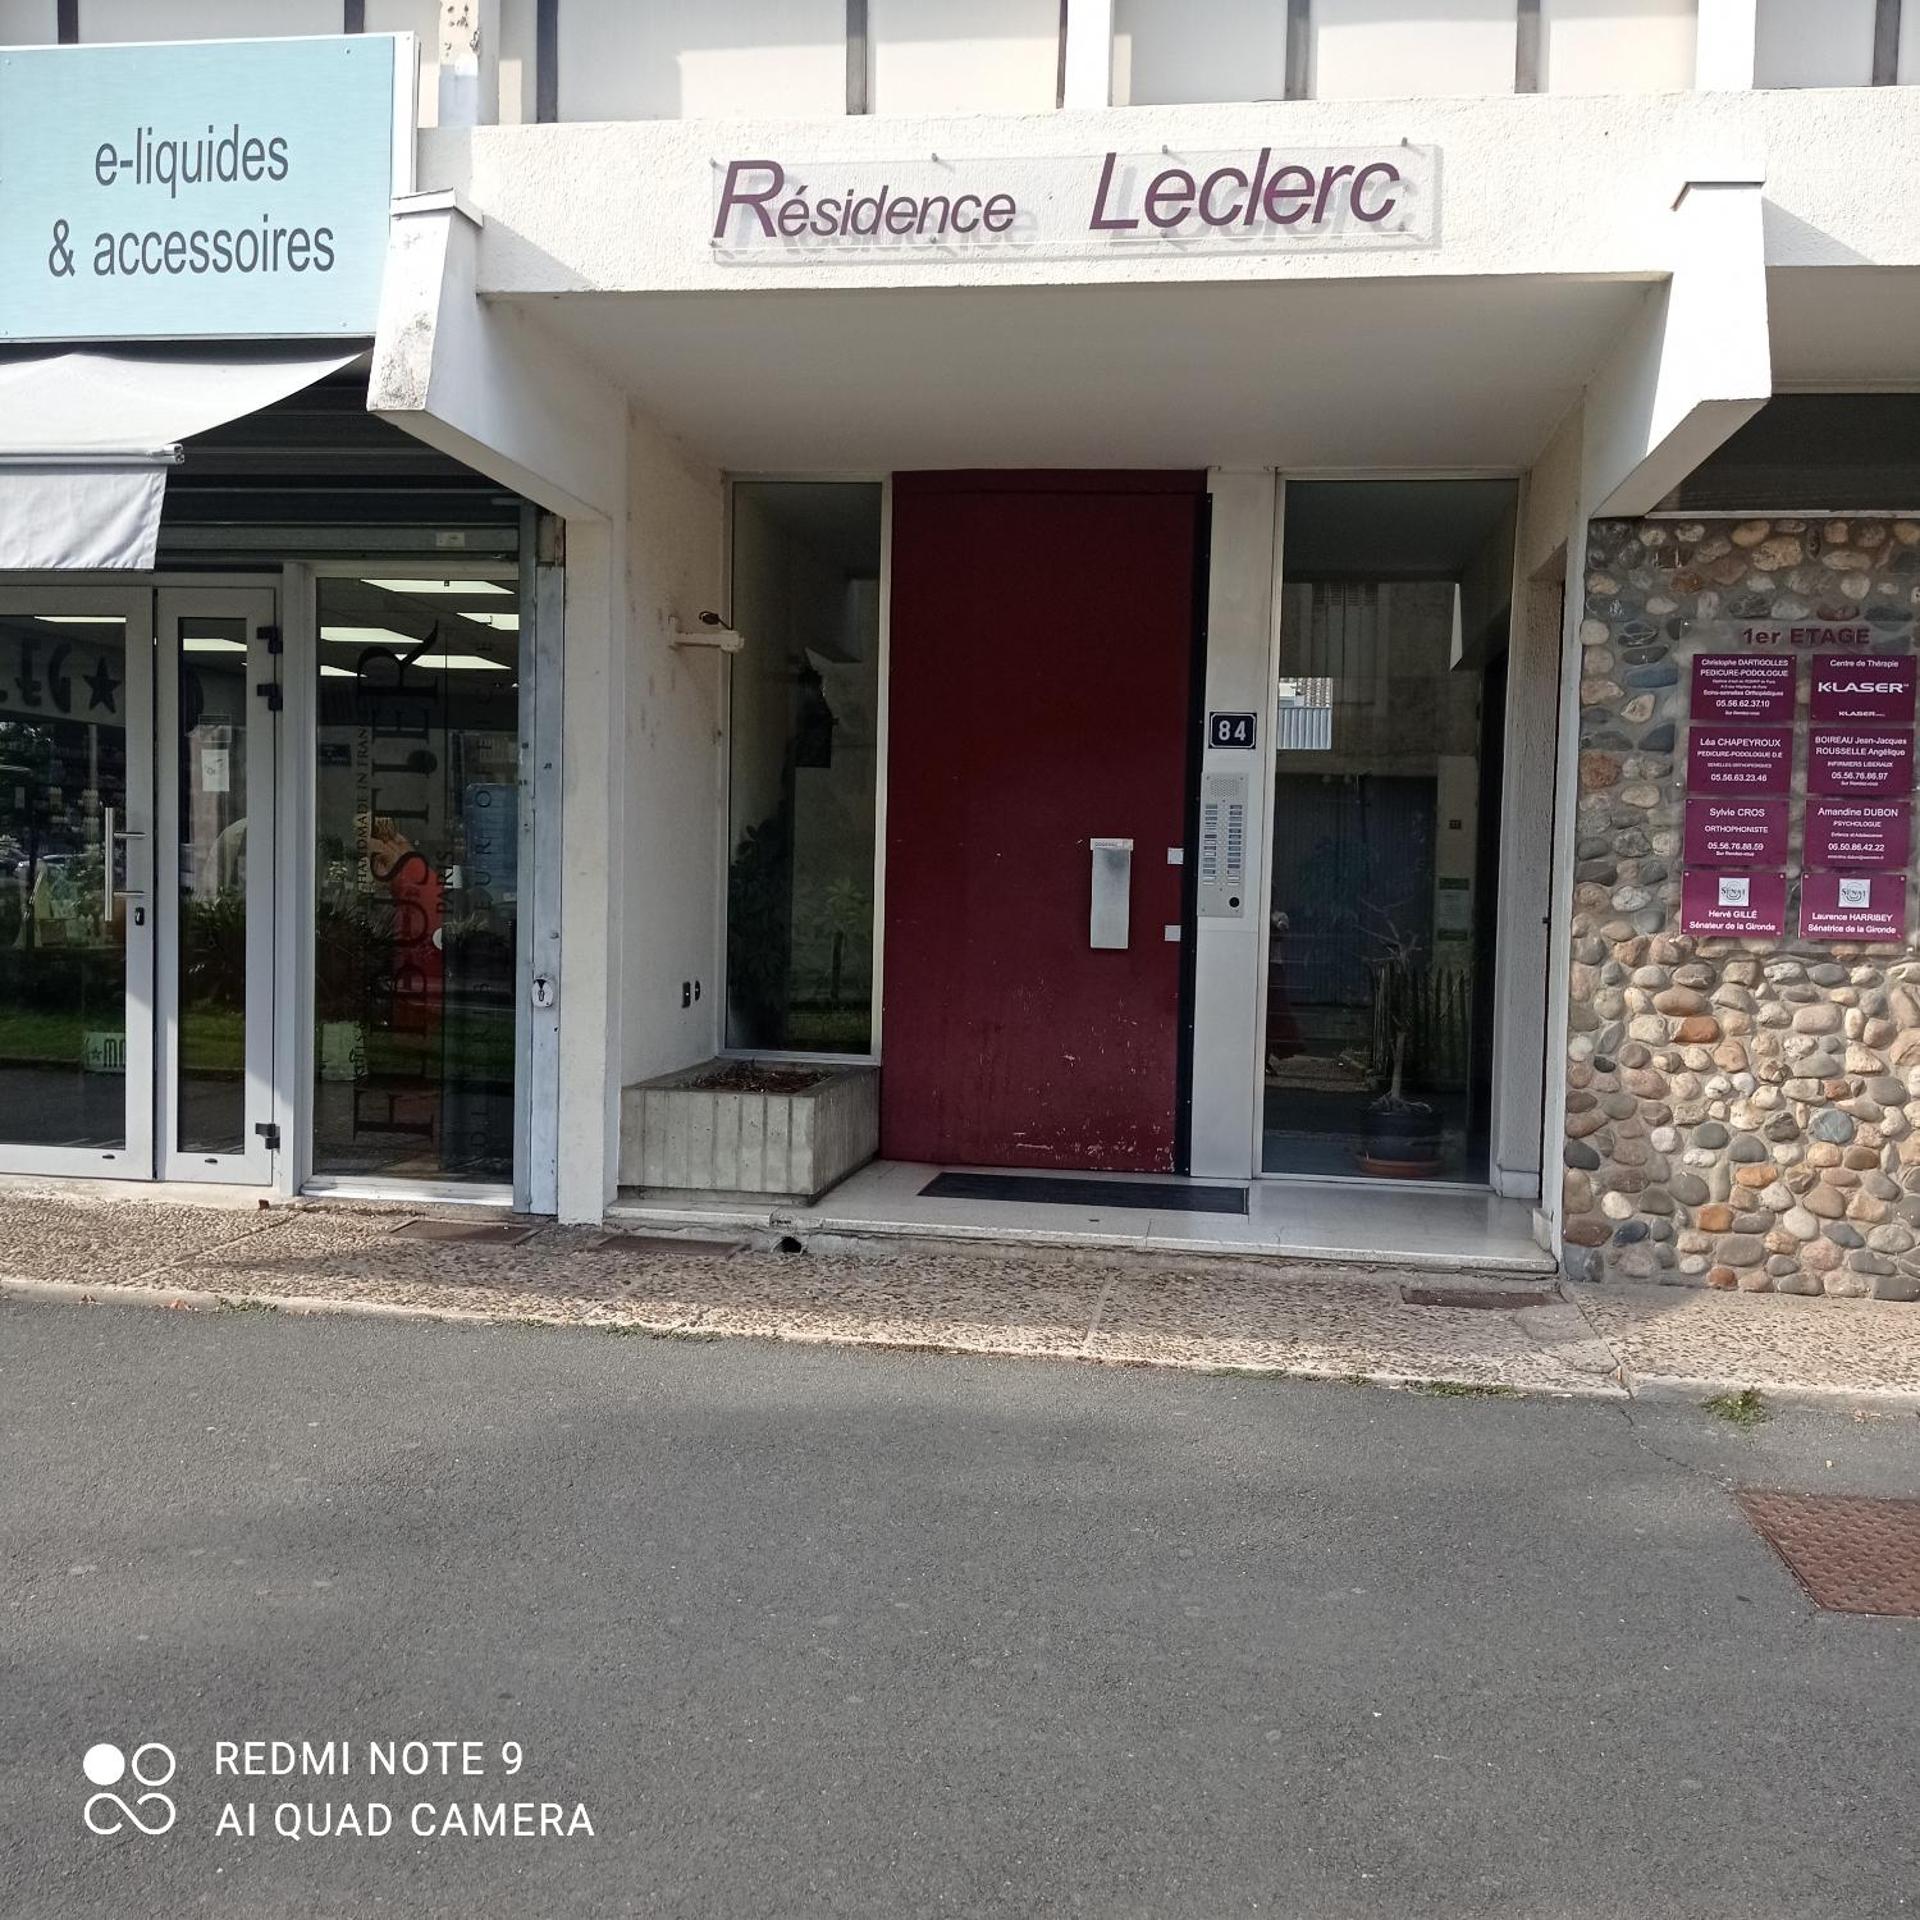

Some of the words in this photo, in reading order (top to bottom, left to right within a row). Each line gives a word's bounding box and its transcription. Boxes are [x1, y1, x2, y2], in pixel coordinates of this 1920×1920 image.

[95, 124, 289, 199] e-liquides
[713, 159, 1016, 239] Résidence
[1089, 147, 1401, 231] Leclerc
[48, 218, 77, 278] &
[93, 213, 336, 277] accessoires
[1743, 628, 1781, 644] 1er
[1790, 627, 1870, 645] ETAGE
[1867, 660, 1899, 668] Thérapie
[1218, 719, 1247, 742] 84
[1700, 738, 1716, 746] Léa
[1717, 738, 1782, 747] CHAPEYROUX
[1816, 747, 1867, 755] ROUSSELLE
[1709, 808, 1735, 818] Sylvie
[1737, 808, 1766, 817] CROS
[1818, 808, 1862, 816] Amandine
[1863, 808, 1899, 817] DUBON
[436, 849, 455, 915] PARIS
[1709, 910, 1732, 918] Hervé
[1812, 913, 1847, 921] Laurence
[1689, 921, 1724, 930] Sénateur
[1725, 922, 1735, 930] de
[1746, 923, 1776, 931] Gironde
[1808, 924, 1844, 932] Sénatrice
[1857, 925, 1864, 933] la
[1865, 925, 1897, 934] Gironde
